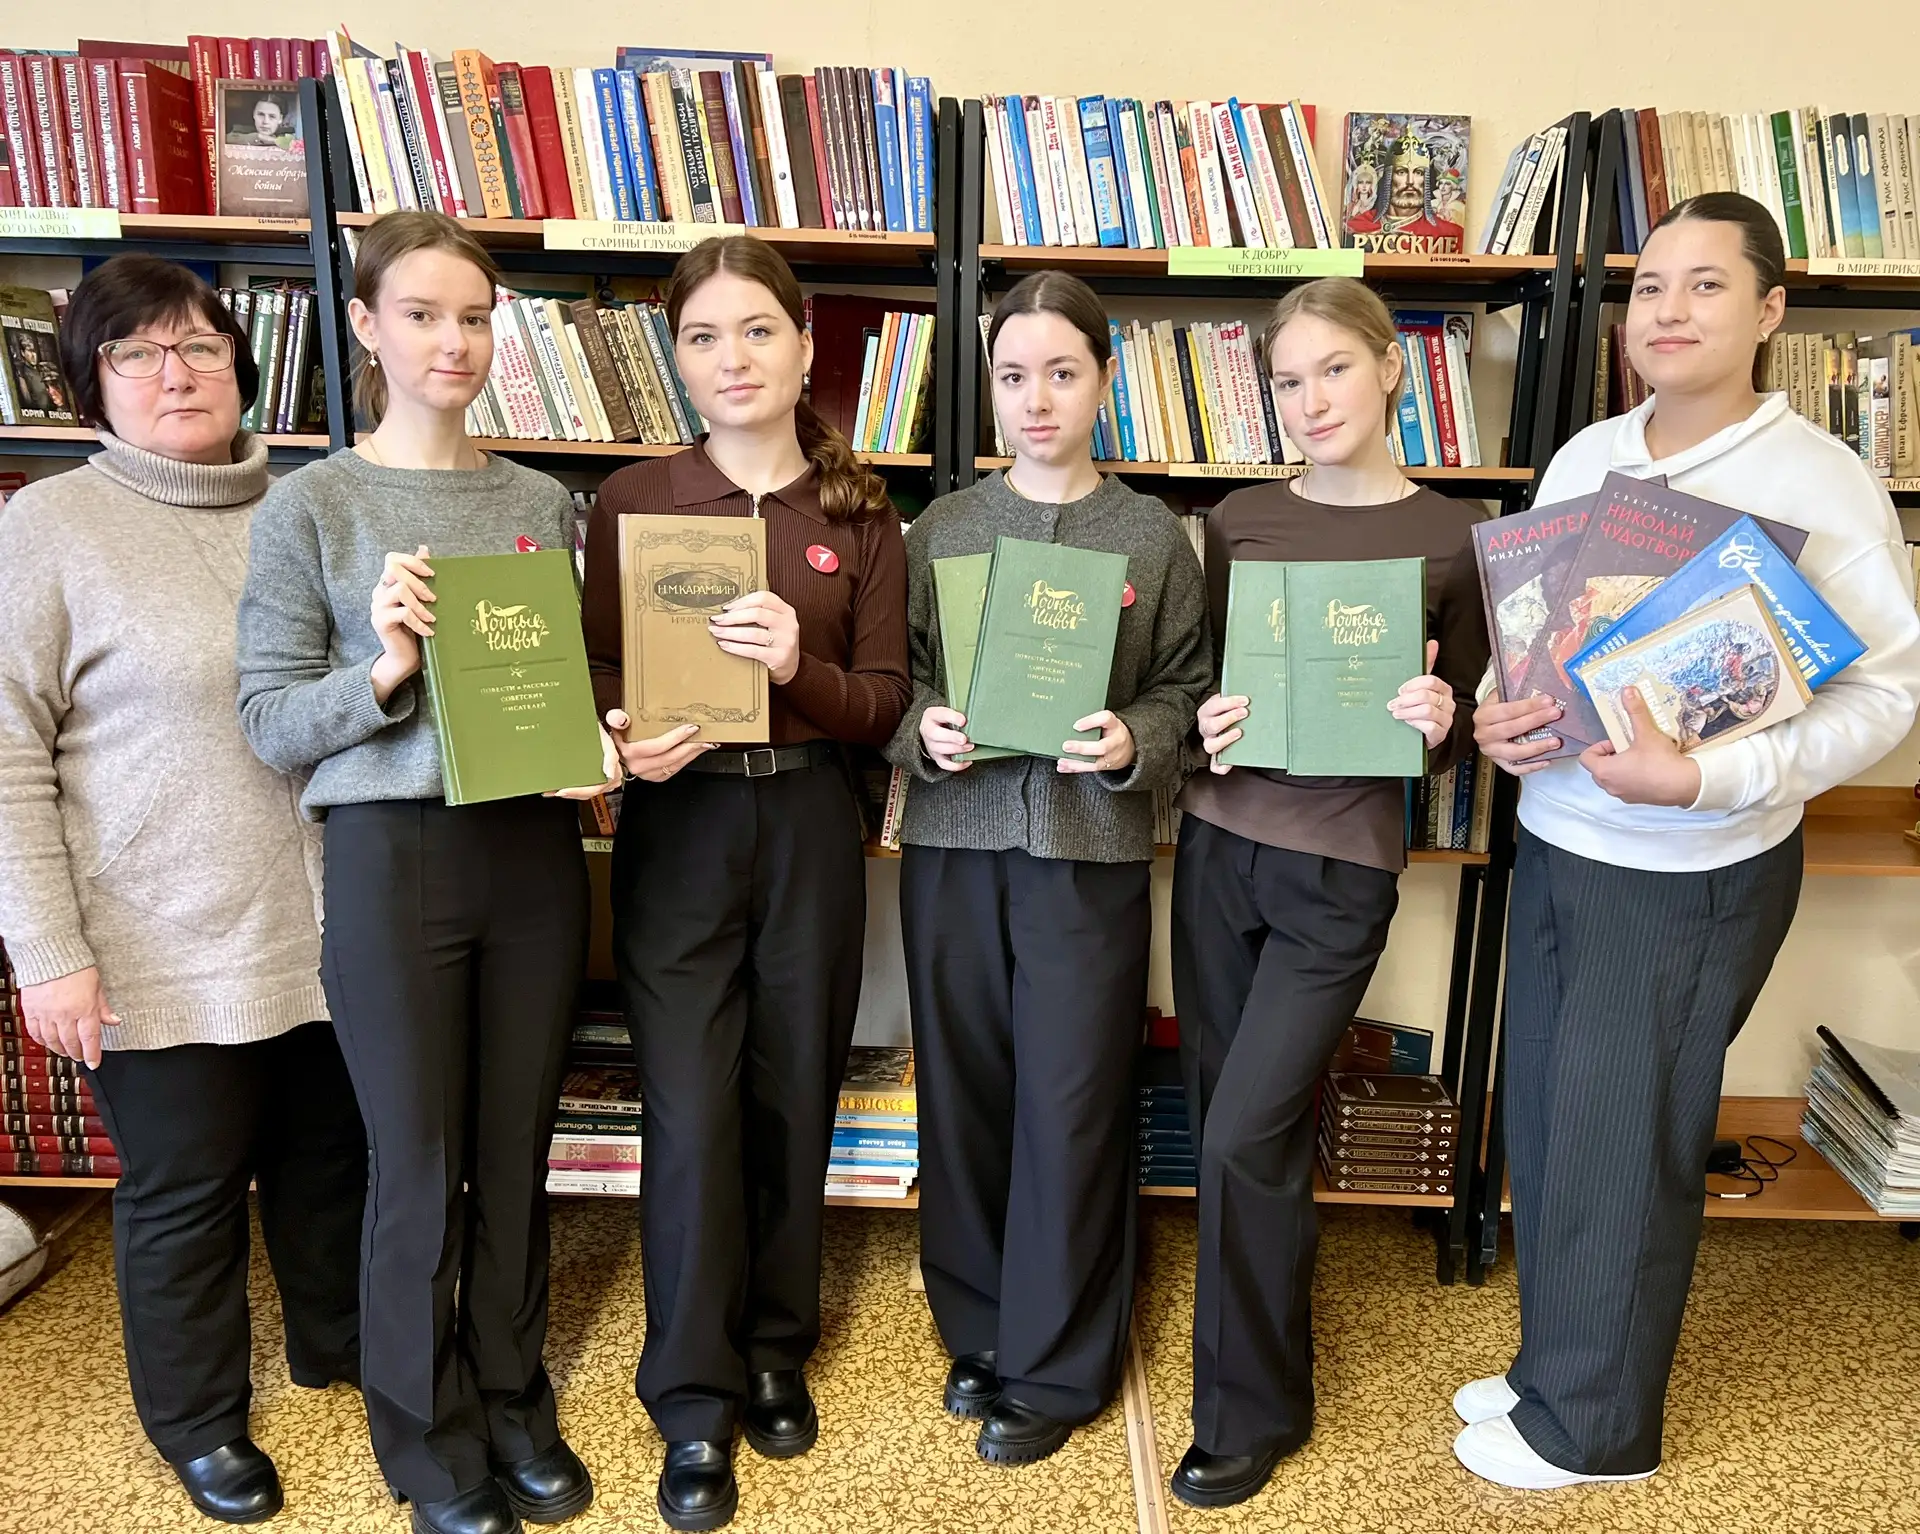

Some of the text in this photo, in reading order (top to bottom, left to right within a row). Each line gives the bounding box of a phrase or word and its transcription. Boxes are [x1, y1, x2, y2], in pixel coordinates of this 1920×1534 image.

[32, 61, 50, 127] ОТЕЧЕСТВЕННОЙ
[65, 64, 82, 129] ОТЕЧЕСТВЕННОЙ
[603, 88, 613, 117] ГРЕЦИИ
[126, 79, 141, 150] ЛЮДИ И ПАМЯТЬ
[677, 103, 689, 137] МИФЫ
[912, 97, 923, 126] ГРЕЦИИ
[606, 118, 617, 152] ДРЕВНЕЙ
[1045, 101, 1060, 150] Дон Кихот
[1219, 109, 1236, 143] СНИЛОСЬ
[914, 127, 924, 161] ДРЕВНЕЙ
[1226, 143, 1238, 153] НЕ
[1878, 127, 1891, 177] АФИНСКАЯ
[228, 164, 273, 178] Женские
[613, 153, 622, 177] МИФЫ
[635, 154, 645, 178] МИФЫ
[685, 149, 700, 189] ЛЕГЕНДЫ
[916, 162, 925, 184] МИФЫ
[1231, 162, 1245, 180] ВАМ
[1898, 128, 1913, 205] ТАИС АФИНСКАЯ
[254, 179, 282, 191] войны
[1207, 167, 1220, 215] ПАВЕЛ БАЖОВ
[918, 196, 927, 229] ЛЕГЕНДЫ
[1531, 186, 1545, 221] ФИЛАТОВ
[613, 223, 675, 235] ПРЕДАНЬЯ
[582, 238, 700, 250] СТАРИНЫ ГЛУБОКО
[1242, 250, 1290, 260] К ДОБРУ
[1352, 233, 1459, 254] РУССКИЕ
[1228, 264, 1303, 274] ЧЕРЕЗ КНИГУ
[1837, 263, 1845, 273] В
[1848, 264, 1880, 273] МИРЕ
[643, 321, 661, 360] ЖИВОТНЫХ
[1431, 336, 1440, 354] ЛУНЕ
[545, 336, 565, 380] БАГРИЦКИЙ
[1434, 355, 1442, 366] НА
[658, 366, 676, 400] РАССКАЗЫ
[1436, 368, 1447, 402] НЕЗНАЙКА
[505, 393, 511, 402] ИЗ
[1117, 391, 1127, 417] МЭРИ
[1812, 390, 1820, 425] фремов
[1898, 391, 1908, 431] Ефремов
[21, 408, 45, 418] ЮРИЙ
[509, 405, 521, 432] СКАЗКИ
[1859, 411, 1869, 459] БРЭДБЕРИ
[1875, 411, 1889, 469] СЭЛИНДЖЕР
[1898, 436, 1906, 459] Иван
[1200, 466, 1245, 475] ЧИТАЕМ
[1249, 465, 1278, 476] ВСЕЙ
[1612, 490, 1699, 525] СВЯТИТЕЛЬ
[1486, 511, 1591, 551] АРХАНГЕЛ
[1605, 503, 1696, 543] НИКОЛАЙ
[1488, 543, 1541, 563] МИХАИЛ
[657, 584, 736, 595] Н.М.КАРАМЗИН
[1031, 579, 1085, 614] Родные
[475, 600, 543, 633] Родные
[1032, 609, 1078, 630] нивы
[1327, 599, 1383, 629] Родные
[486, 630, 543, 651] нивы
[1332, 627, 1381, 647] нивы
[1774, 603, 1836, 665] православной
[481, 685, 516, 694] ПОВЕСТИ
[523, 680, 560, 689] РАССКАЗЫ
[501, 693, 543, 703] СОВЕТСКИХ
[503, 701, 547, 712] ПИСАТЕЛЕЙ
[1639, 679, 1672, 731] БИБЛИЯ
[1529, 733, 1552, 741] ИКОНА
[598, 1124, 636, 1132] детская
[1437, 1153, 1447, 1161] 4
[1436, 1185, 1447, 1193] 6
